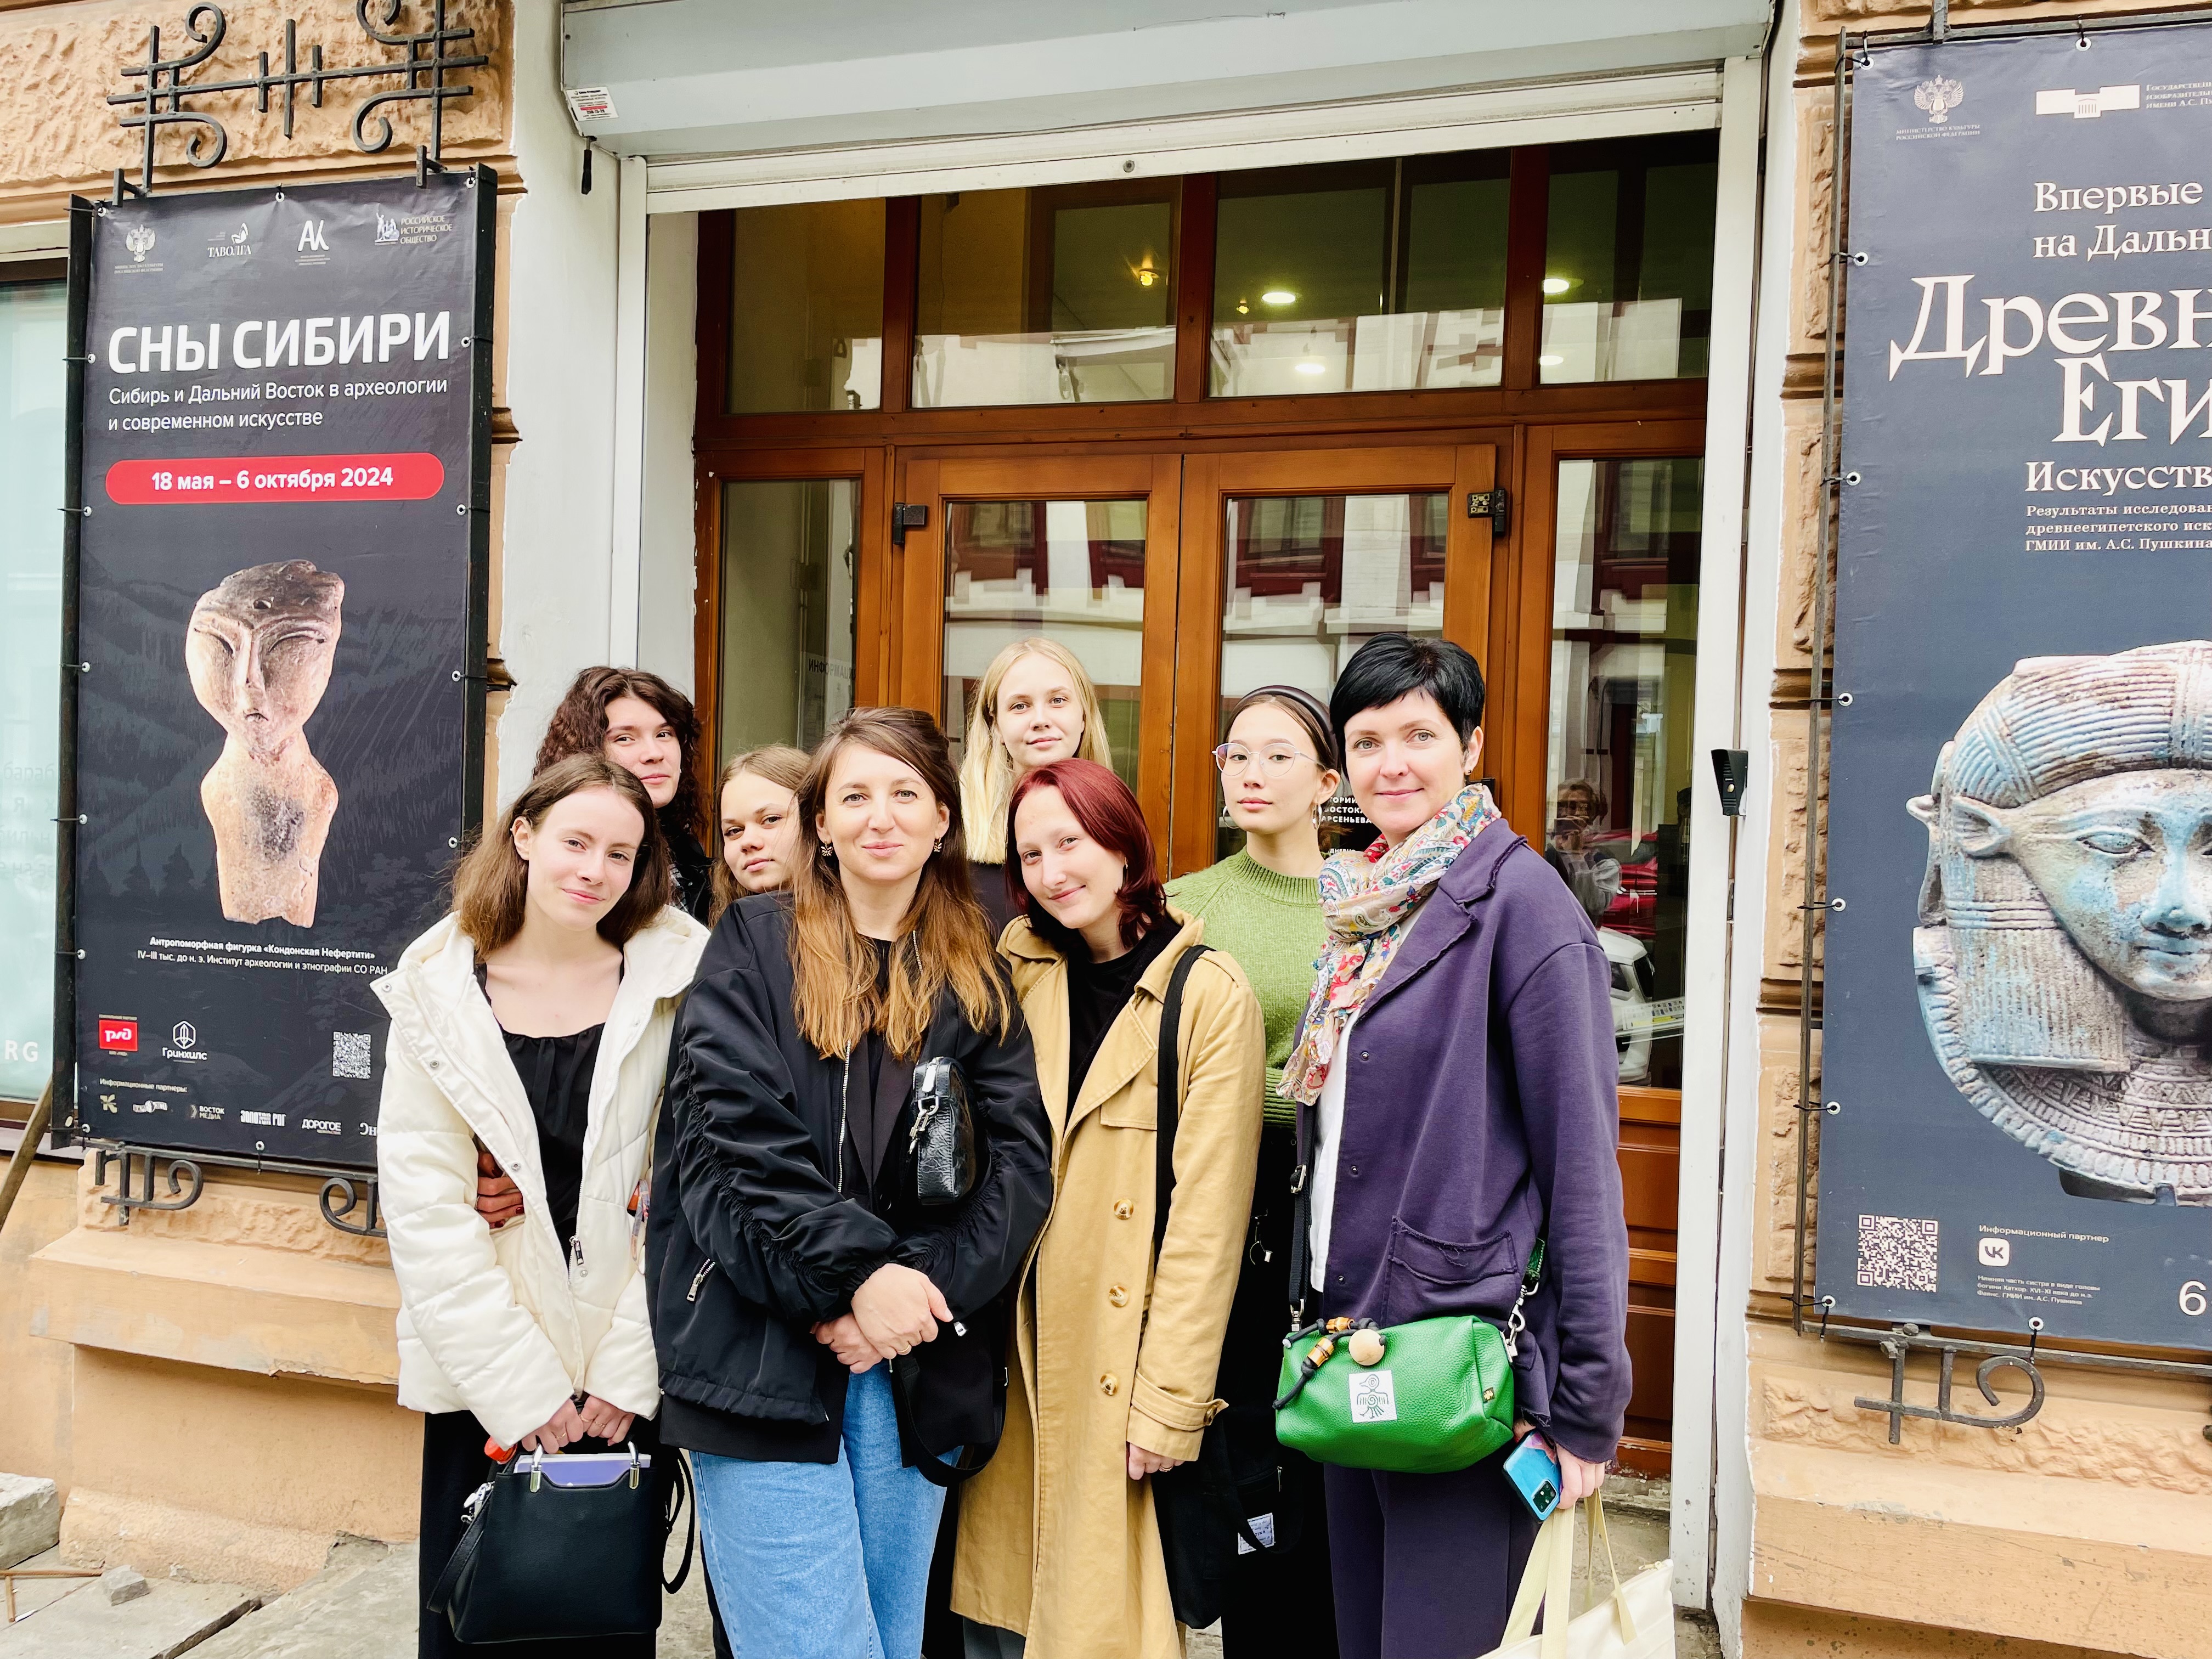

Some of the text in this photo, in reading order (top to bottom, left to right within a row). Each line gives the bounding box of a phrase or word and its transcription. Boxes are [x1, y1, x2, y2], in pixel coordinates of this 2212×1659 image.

[2034, 181, 2203, 215] Впервые
[400, 215, 445, 225] РОССИЙСКОЕ
[297, 219, 329, 251] АК
[400, 223, 453, 235] ИСТОРИЧЕСКОЕ
[400, 235, 437, 244] ОБЩЕСТВО
[2033, 224, 2212, 262] на Дальн
[207, 245, 251, 258] ТАВОЛГА
[109, 311, 449, 374] СНЫ СИБИРИ
[109, 379, 447, 407] Сибирь и Дальний Восток в археологии
[109, 411, 323, 433] и современном искусстве
[151, 472, 173, 490] 18
[177, 474, 214, 490] мая
[236, 470, 250, 488] 6
[255, 469, 335, 492] октября
[341, 467, 393, 487] 2024
[2025, 461, 2212, 496] Искусств
[2026, 505, 2118, 518] Результаты
[2025, 522, 2179, 536] древнеегипетского
[2025, 538, 2212, 552] ГМИИ им. А.С. Пушкина
[150, 936, 375, 960] Антропоморфная фигурка «Кондонская Нефертити»
[159, 953, 176, 962] тыс.
[207, 955, 242, 968] Институт
[244, 959, 293, 969] археологии
[302, 962, 352, 974] этнографии
[354, 964, 367, 974] СО
[369, 966, 388, 975] РАН
[162, 1047, 207, 1060] Гринхилс
[99, 1077, 188, 1093] Информационные партнеры:
[199, 1105, 225, 1115] ВОСТОК
[199, 1112, 221, 1120] МЕДИА
[272, 1113, 287, 1127] РОГ
[301, 1118, 342, 1132] ДОРОГОЕ
[1979, 1224, 2109, 1244] Информационный партнер
[1977, 1282, 2002, 1290] богини
[2002, 1292, 2023, 1300] ГМИИ
[2179, 1280, 2208, 1316] 6
